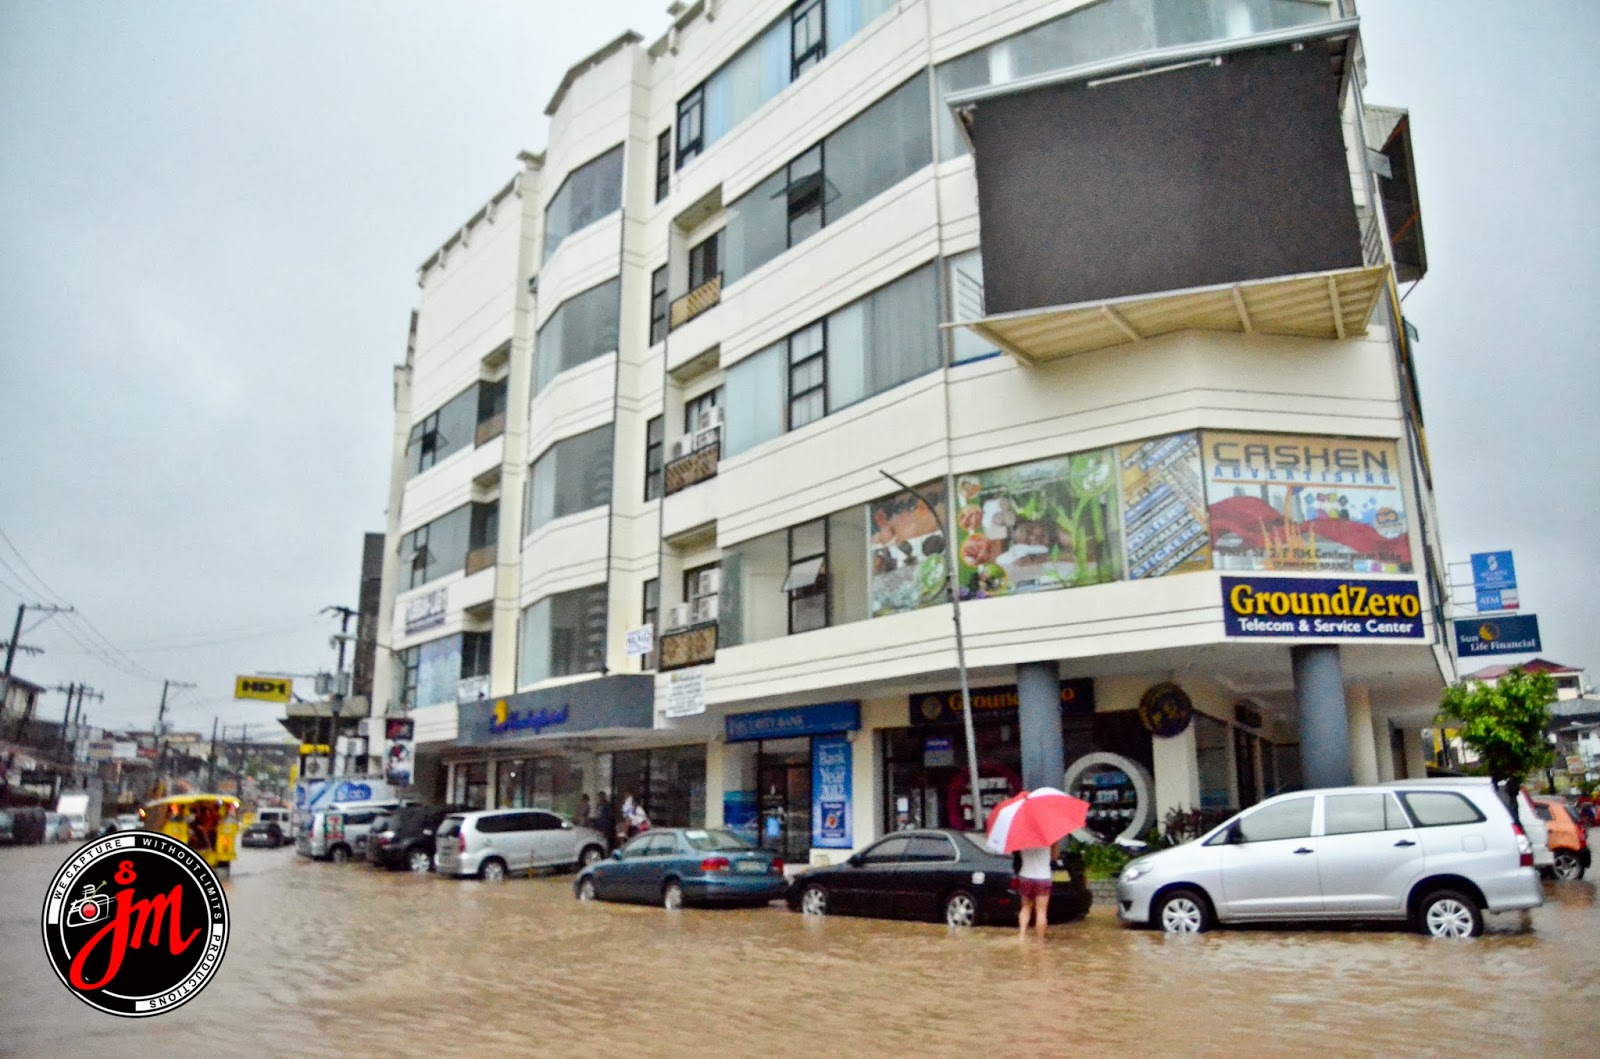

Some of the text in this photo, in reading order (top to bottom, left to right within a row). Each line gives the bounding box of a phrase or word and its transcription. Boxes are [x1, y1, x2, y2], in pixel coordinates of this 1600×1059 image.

[1213, 442, 1388, 470] CASHEN
[1214, 465, 1391, 484] ADVERTISING
[1130, 522, 1204, 577] STICKERS
[1230, 584, 1420, 617] GroundZero
[1238, 618, 1413, 633] Telecom & Service Center
[1460, 634, 1479, 643] Sun
[1470, 639, 1536, 652] Life Financial
